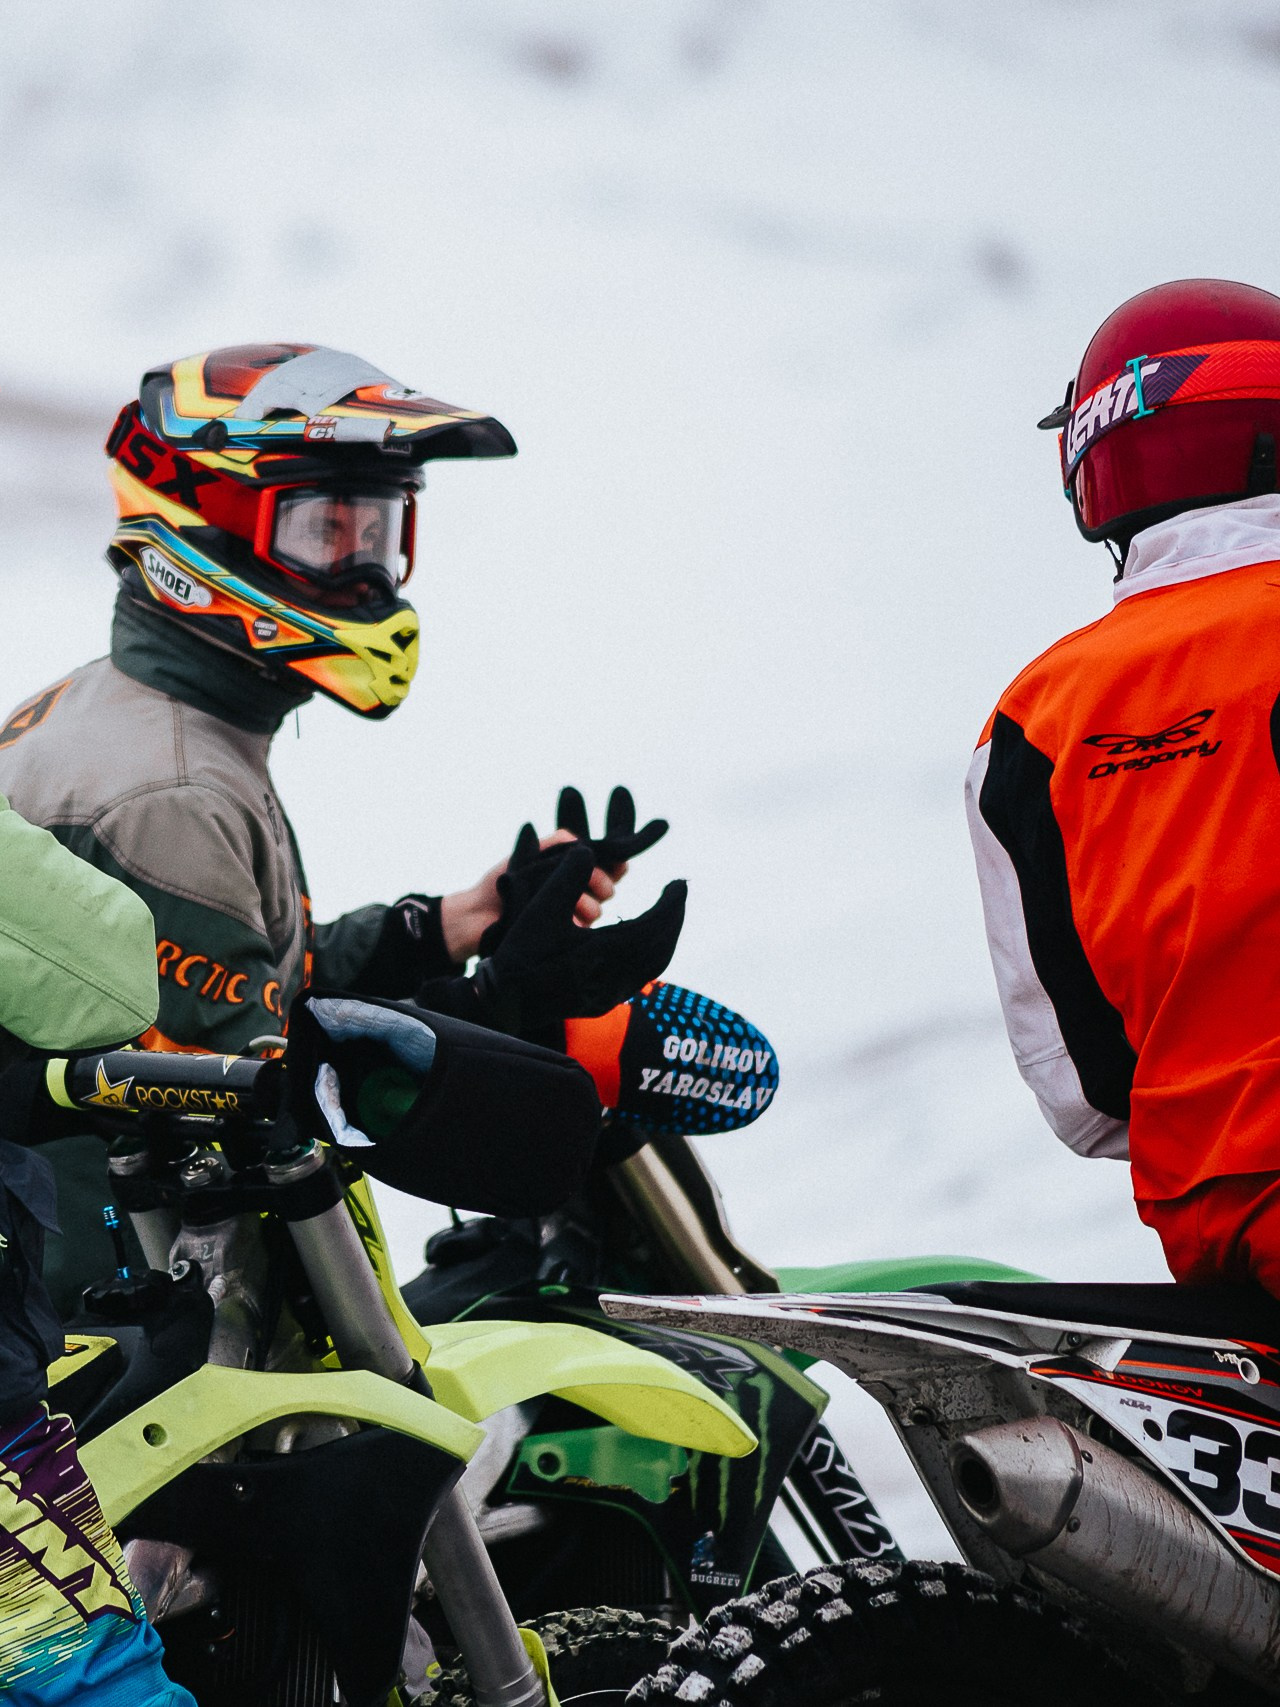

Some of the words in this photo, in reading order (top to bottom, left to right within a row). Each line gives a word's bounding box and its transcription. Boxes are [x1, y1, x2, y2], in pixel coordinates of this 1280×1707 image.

[147, 553, 192, 601] SHOEI
[155, 939, 249, 1004] RCTIC
[662, 1034, 772, 1075] GOLIKOV
[638, 1067, 774, 1111] YAROSLAV
[690, 1573, 741, 1587] BUGREEV
